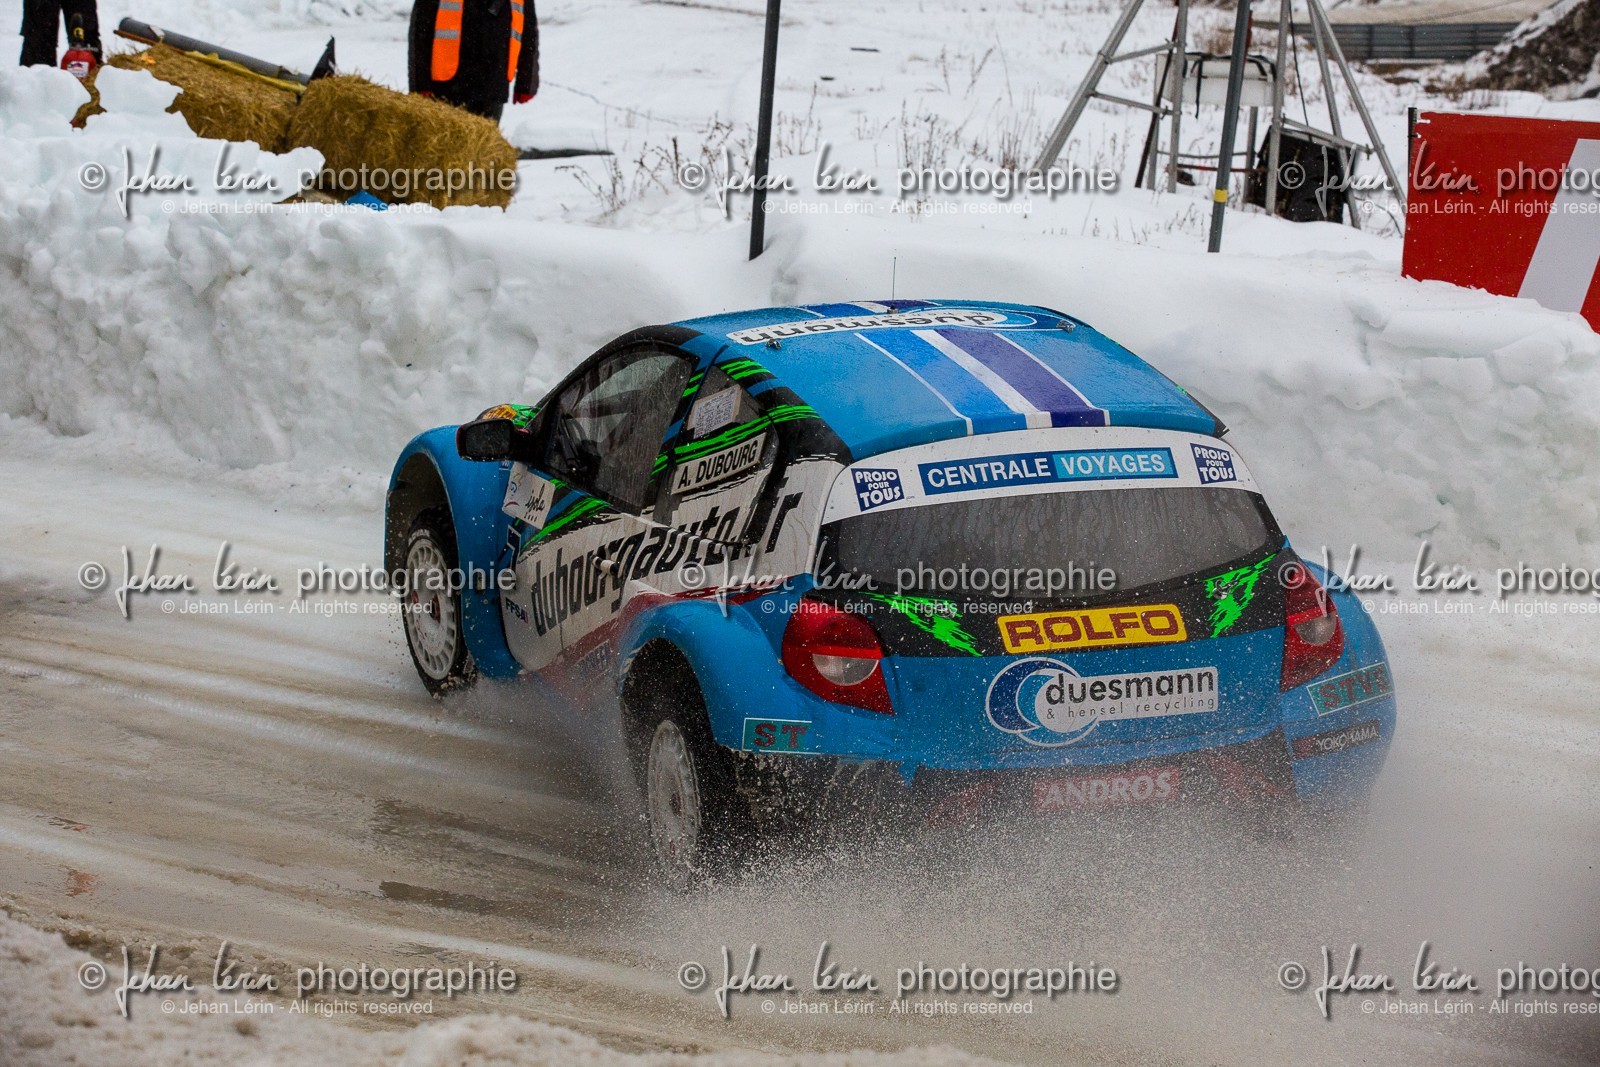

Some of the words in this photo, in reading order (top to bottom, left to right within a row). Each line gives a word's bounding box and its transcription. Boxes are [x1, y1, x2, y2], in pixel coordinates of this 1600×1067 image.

[741, 313, 995, 343] duesmann
[677, 465, 692, 490] A.
[695, 440, 759, 484] DUBOURG
[1194, 446, 1230, 461] PROJO
[1205, 459, 1225, 468] POUR
[855, 471, 898, 484] PROJO
[927, 458, 1051, 488] CENTRALE
[1060, 454, 1166, 475] VOYAGES
[1200, 467, 1234, 482] TOUS
[859, 486, 902, 508] TOUS
[867, 481, 890, 491] POUR
[1005, 609, 1179, 648] ROLFO
[1045, 671, 1215, 705] duesmann
[1046, 709, 1055, 720] &
[1068, 701, 1124, 718] hensel
[1136, 697, 1215, 715] recycling
[1042, 770, 1172, 806] ANDROS
